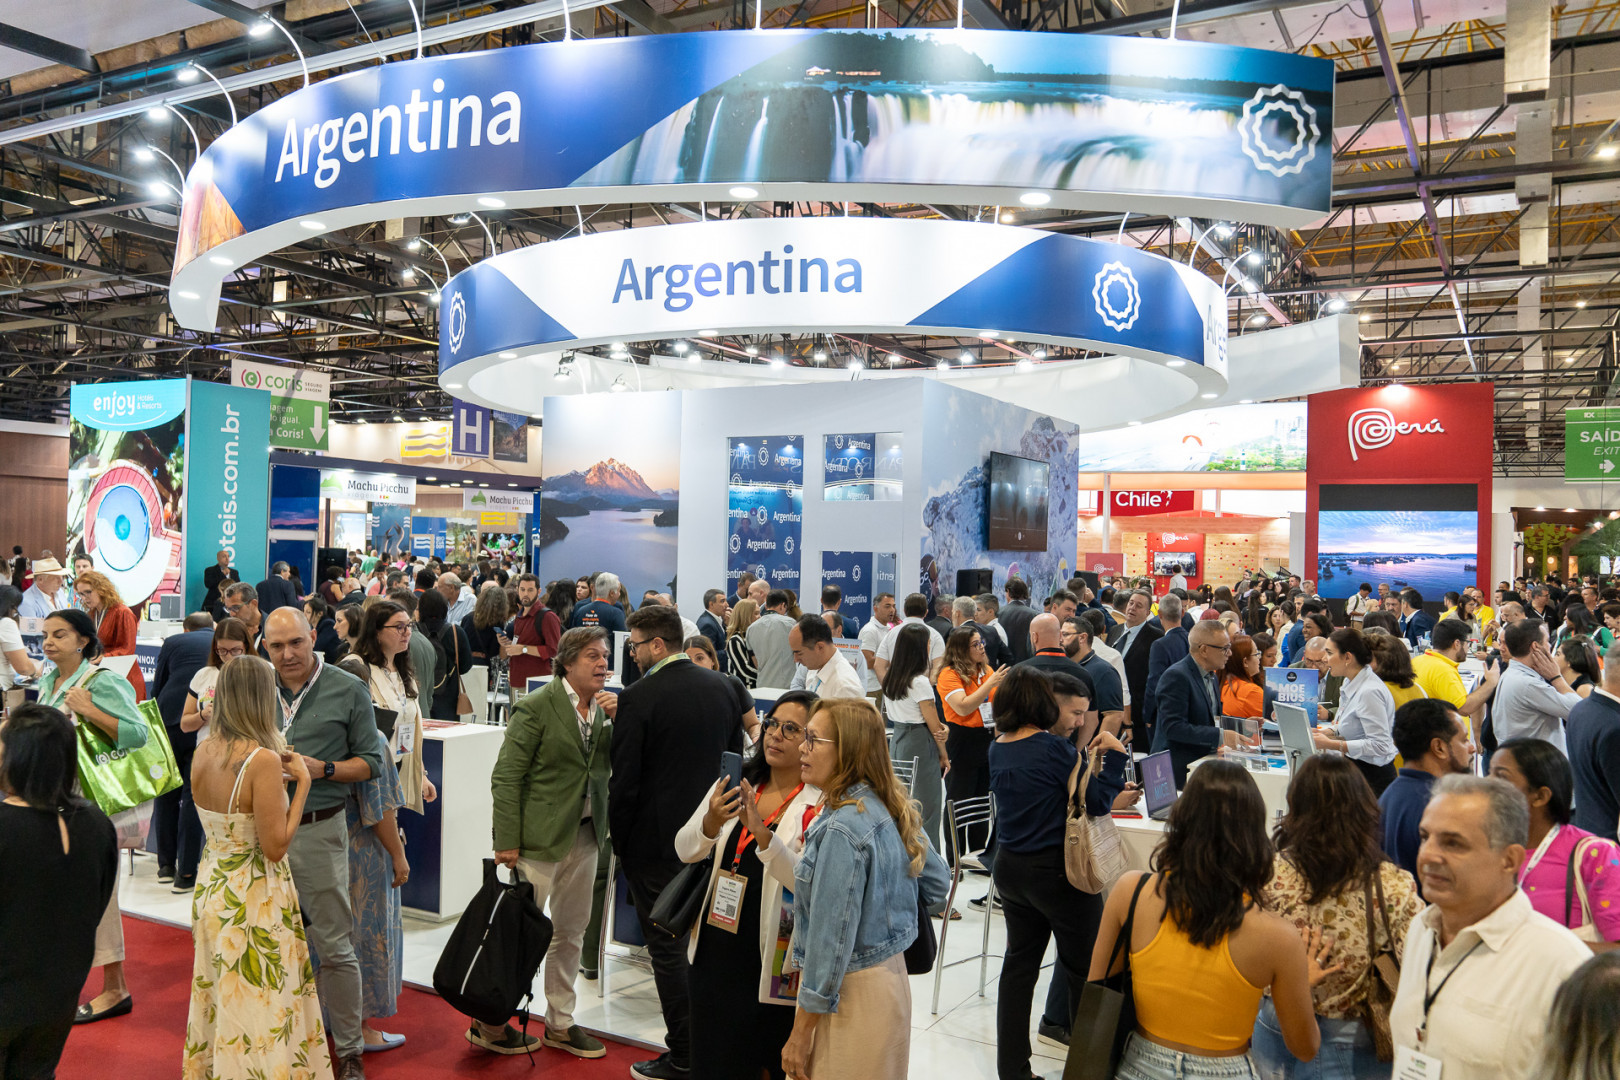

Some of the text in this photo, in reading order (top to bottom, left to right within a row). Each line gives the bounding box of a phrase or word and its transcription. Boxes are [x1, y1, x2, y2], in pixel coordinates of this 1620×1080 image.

[274, 77, 522, 189] Argentina
[612, 244, 862, 312] Argentina
[264, 375, 302, 392] coris
[93, 390, 136, 418] enjoy
[276, 428, 304, 439] Coris!
[460, 408, 482, 452] H
[1348, 408, 1445, 462] Perú
[848, 438, 871, 450] Argentina
[1594, 446, 1620, 456] EXIT
[774, 453, 802, 466] Argentina
[824, 458, 848, 473] Argentina
[348, 480, 409, 494] Machu Picchu
[490, 496, 532, 506] Machu Picchu
[1115, 491, 1162, 507] Chile
[773, 510, 800, 524] Argentina
[746, 538, 776, 552] Argentina
[772, 568, 799, 581] Argentina
[822, 568, 846, 580] Argentina
[844, 594, 868, 606] Argentina
[1278, 683, 1306, 693] MOE
[1278, 693, 1306, 702] BIUS
